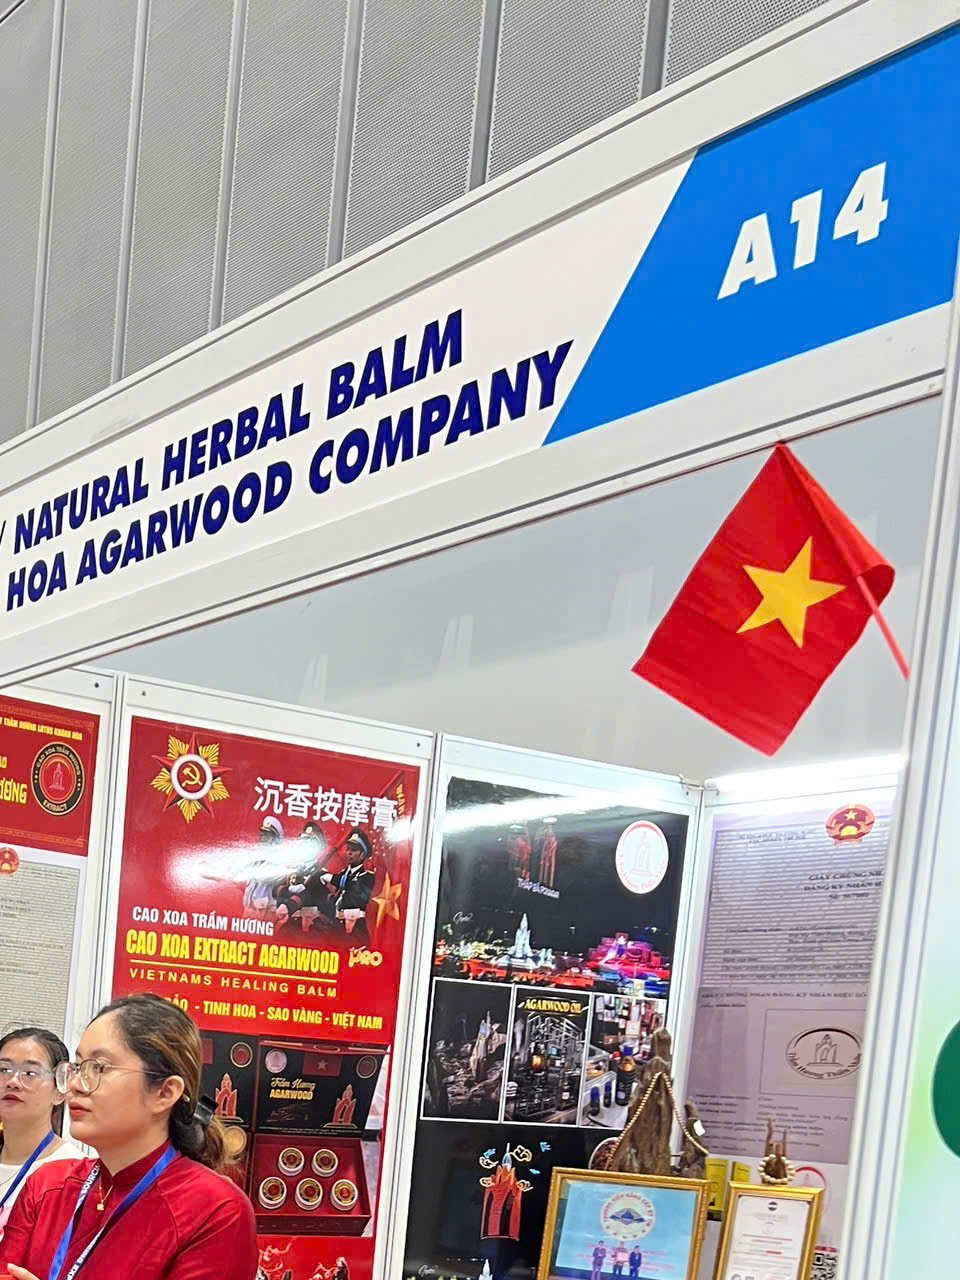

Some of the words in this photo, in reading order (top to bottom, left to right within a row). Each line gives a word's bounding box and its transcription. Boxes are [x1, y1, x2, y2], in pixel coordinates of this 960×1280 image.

[718, 163, 889, 300] A14
[13, 457, 149, 555] NATURAL
[161, 382, 311, 491] HERBAL
[327, 308, 462, 420] BALM
[6, 551, 68, 612] HOA
[75, 460, 292, 585] AGARWOOD
[309, 338, 574, 495] COMPANY
[132, 906, 159, 923] CAO
[162, 909, 188, 926] XOA
[231, 917, 274, 936] HƯƠNG
[126, 929, 157, 956] CAO
[160, 933, 190, 959] XOA
[193, 937, 257, 966] EXTRACT
[259, 943, 339, 975] AGARWOOD
[129, 967, 212, 986] VIETNAMS
[221, 976, 289, 994] HEALING
[297, 984, 338, 998] BALM
[203, 1001, 231, 1016] TINH
[233, 1003, 257, 1018] HOA
[267, 1006, 291, 1021] SAO
[292, 1007, 323, 1025] VÀNG
[332, 1011, 356, 1030] VIỆT
[357, 1015, 383, 1030] NAM
[524, 998, 570, 1013] AGARWOOD
[269, 1088, 314, 1101] AGARWOOD
